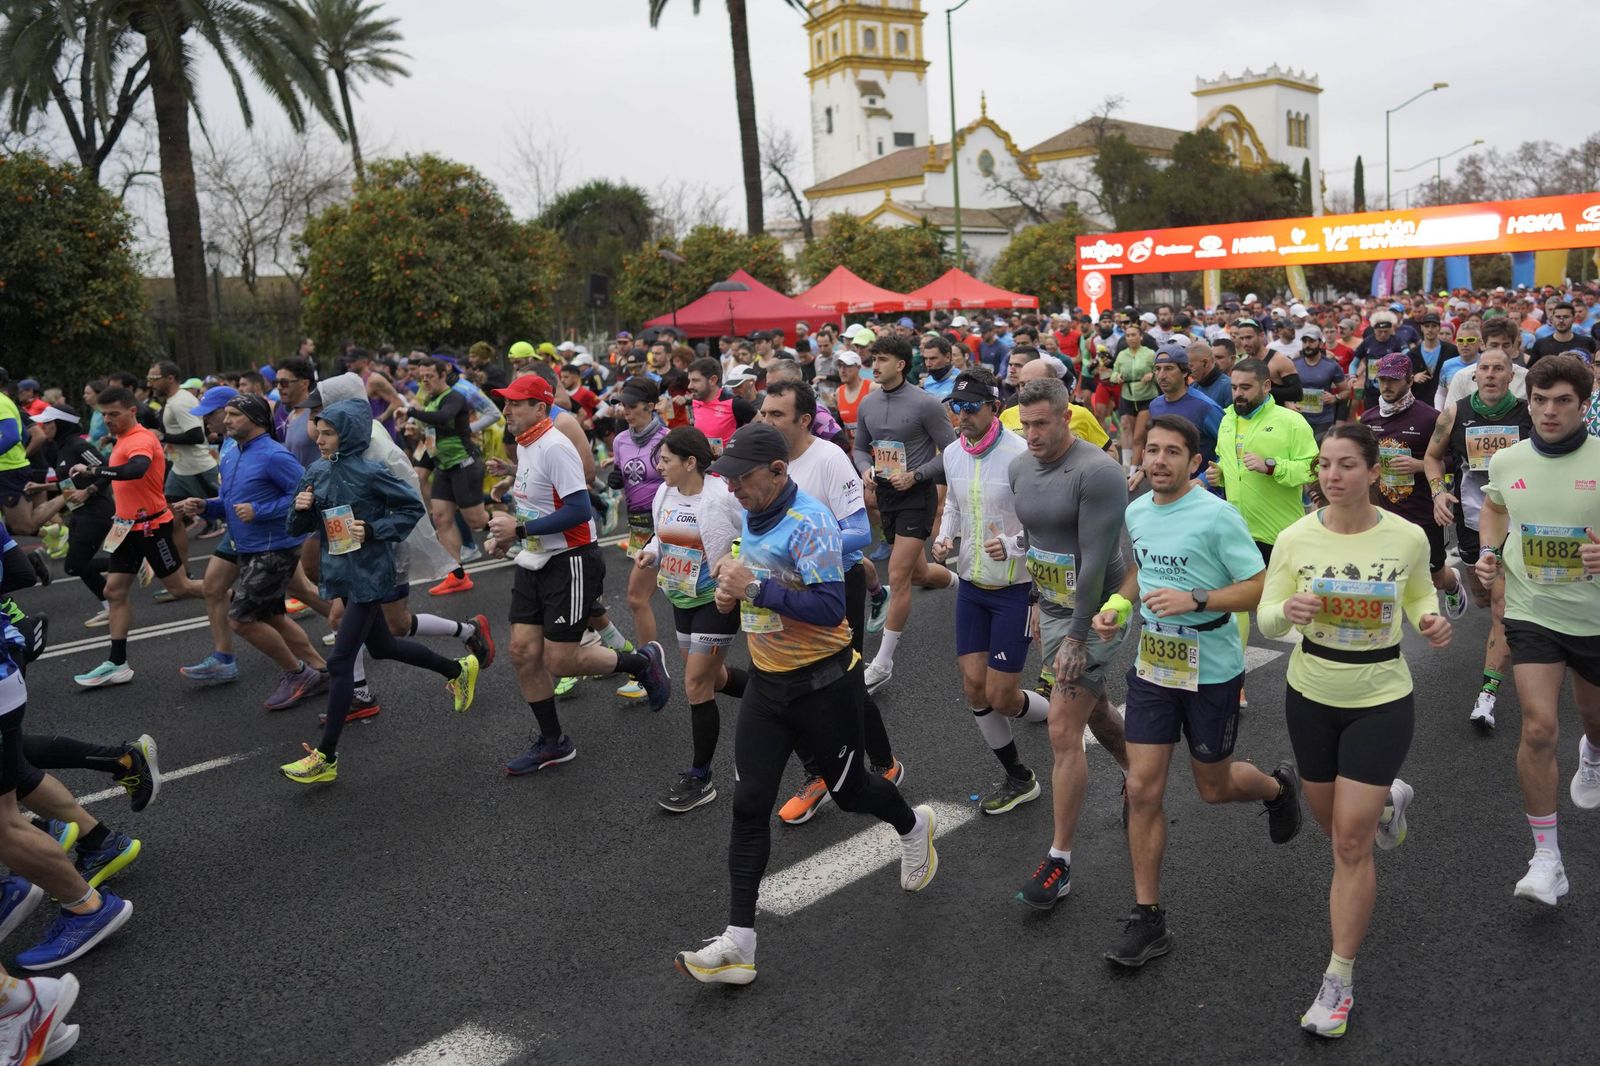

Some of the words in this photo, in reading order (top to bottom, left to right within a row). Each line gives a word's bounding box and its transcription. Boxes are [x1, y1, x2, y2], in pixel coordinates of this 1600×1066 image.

[1506, 212, 1566, 234] HOKA
[1474, 437, 1507, 450] 7849
[1527, 539, 1582, 559] 11882
[1151, 555, 1188, 566] VICKY
[1033, 562, 1059, 583] 9211
[1321, 596, 1382, 620] 13339
[1143, 634, 1188, 661] 13338
